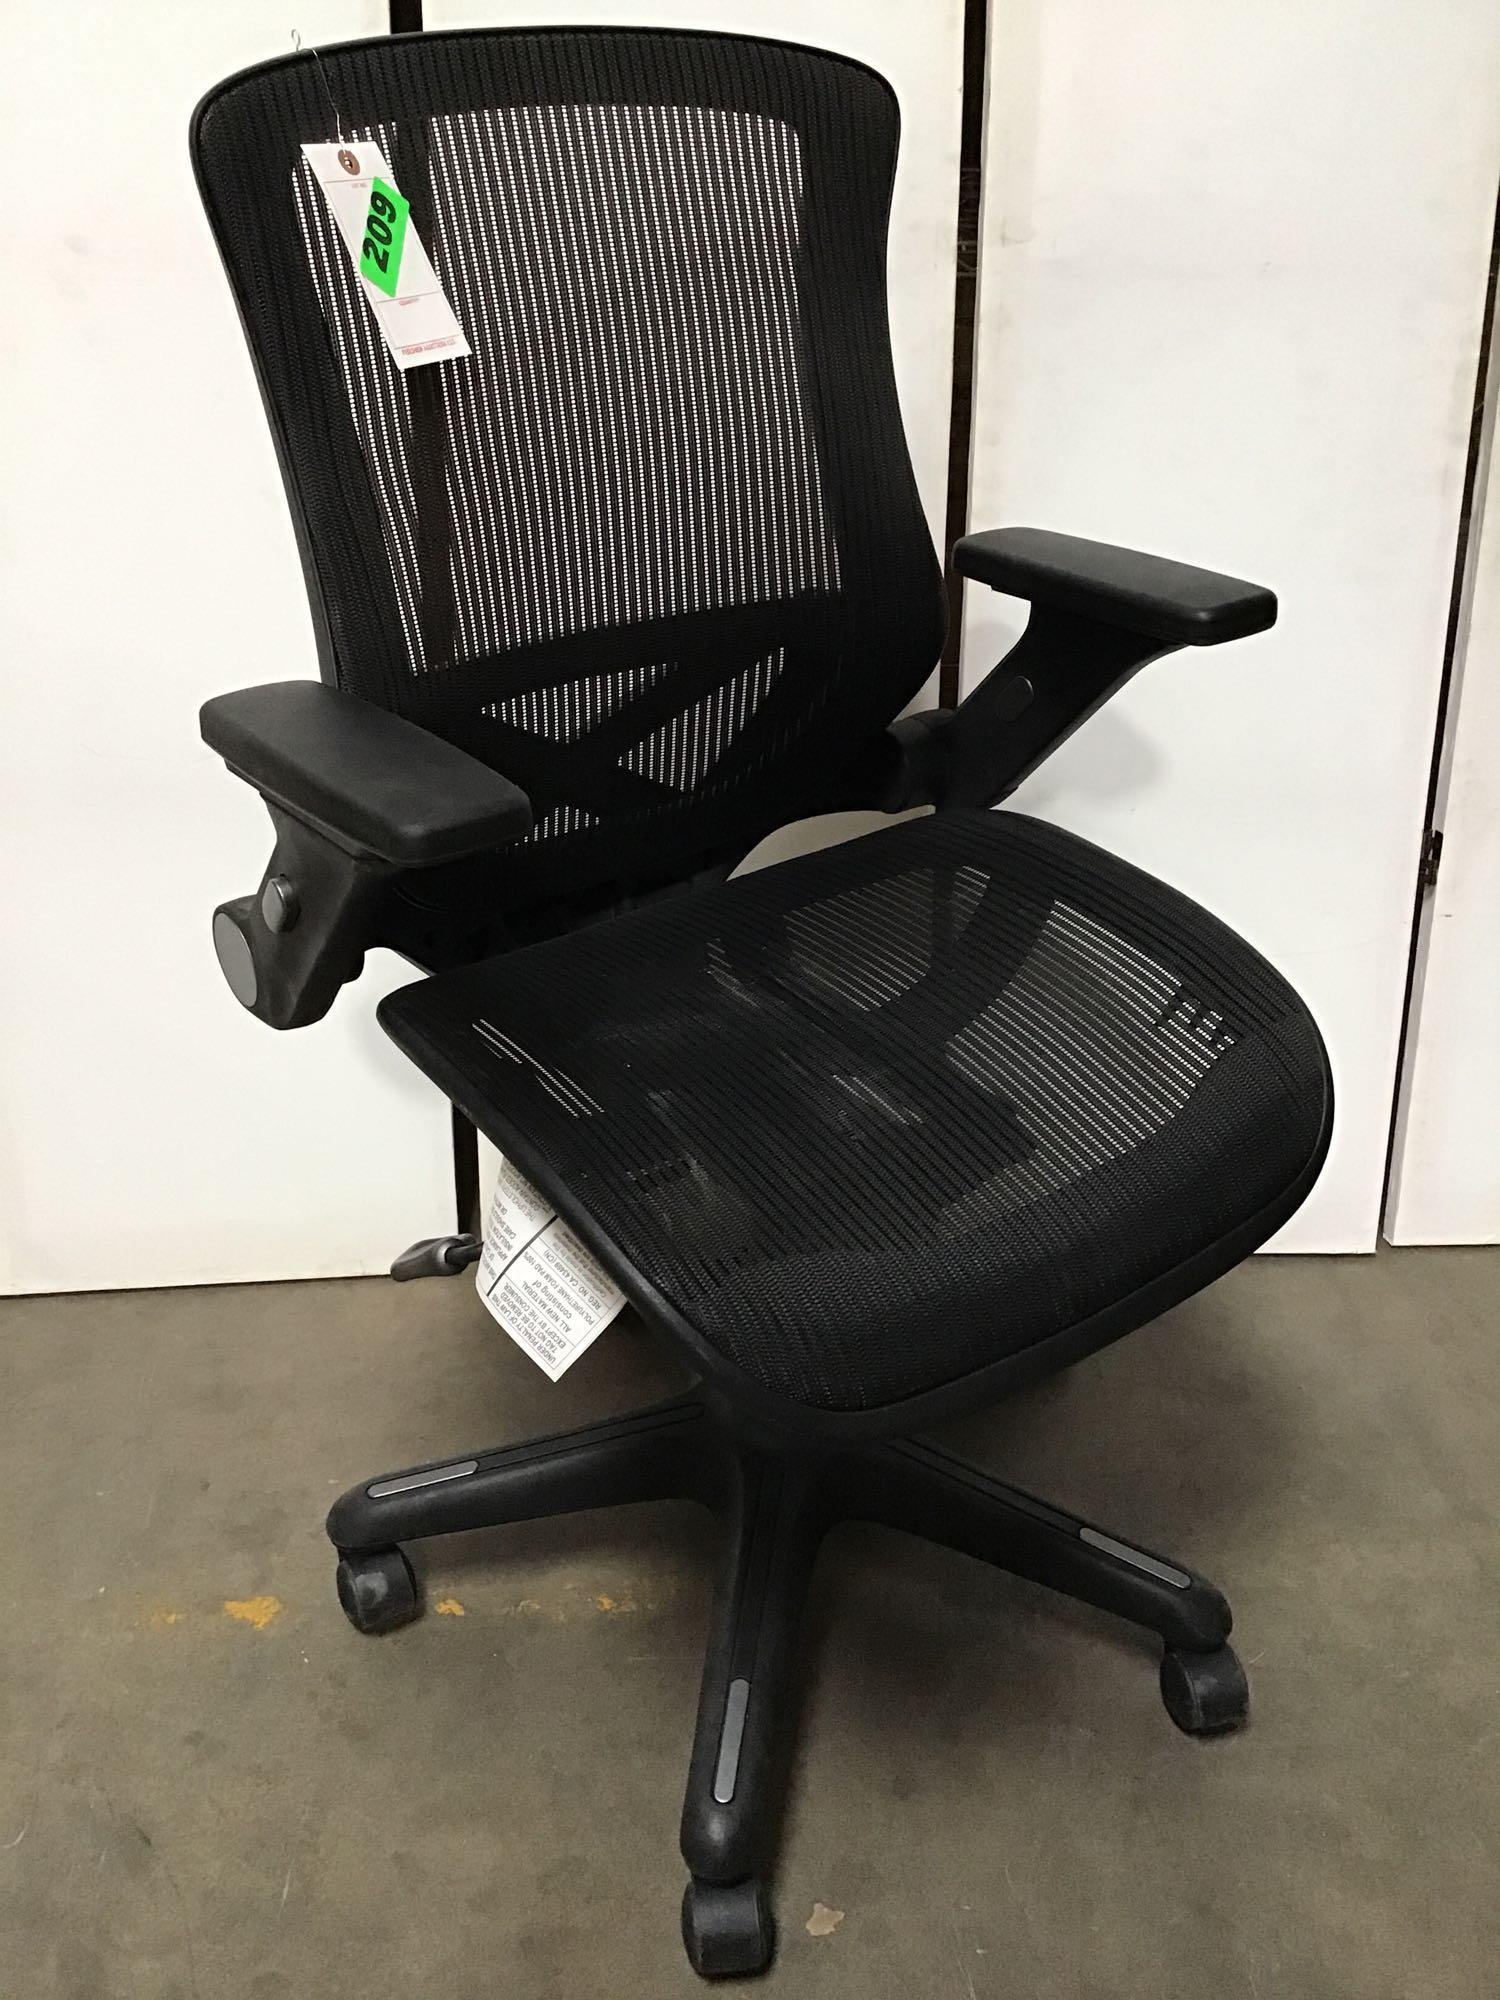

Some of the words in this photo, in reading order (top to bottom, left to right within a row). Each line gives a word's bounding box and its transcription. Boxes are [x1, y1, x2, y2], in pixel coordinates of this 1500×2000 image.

[362, 191, 396, 274] 209
[532, 1262, 547, 1276] PAD
[531, 1278, 543, 1290] of
[542, 1271, 560, 1290] FOAM
[567, 1275, 580, 1288] CA
[519, 1279, 549, 1310] MATERIAL
[498, 1290, 524, 1317] REMOVED
[498, 1303, 512, 1317] LAW
[538, 1284, 574, 1321] consisting
[555, 1285, 595, 1326] POLYURETHANE
[507, 1314, 519, 1325] OF
[519, 1313, 530, 1325] BE
[526, 1308, 541, 1322] THE
[544, 1306, 561, 1323] NEW
[526, 1320, 537, 1332] TO
[536, 1318, 548, 1330] BY
[556, 1318, 572, 1334] ALL
[513, 1320, 540, 1347] PENALTY
[534, 1328, 547, 1342] NOT
[544, 1326, 566, 1349] EXCEPT
[535, 1342, 557, 1364] UNDER
[543, 1338, 558, 1353] TAG
